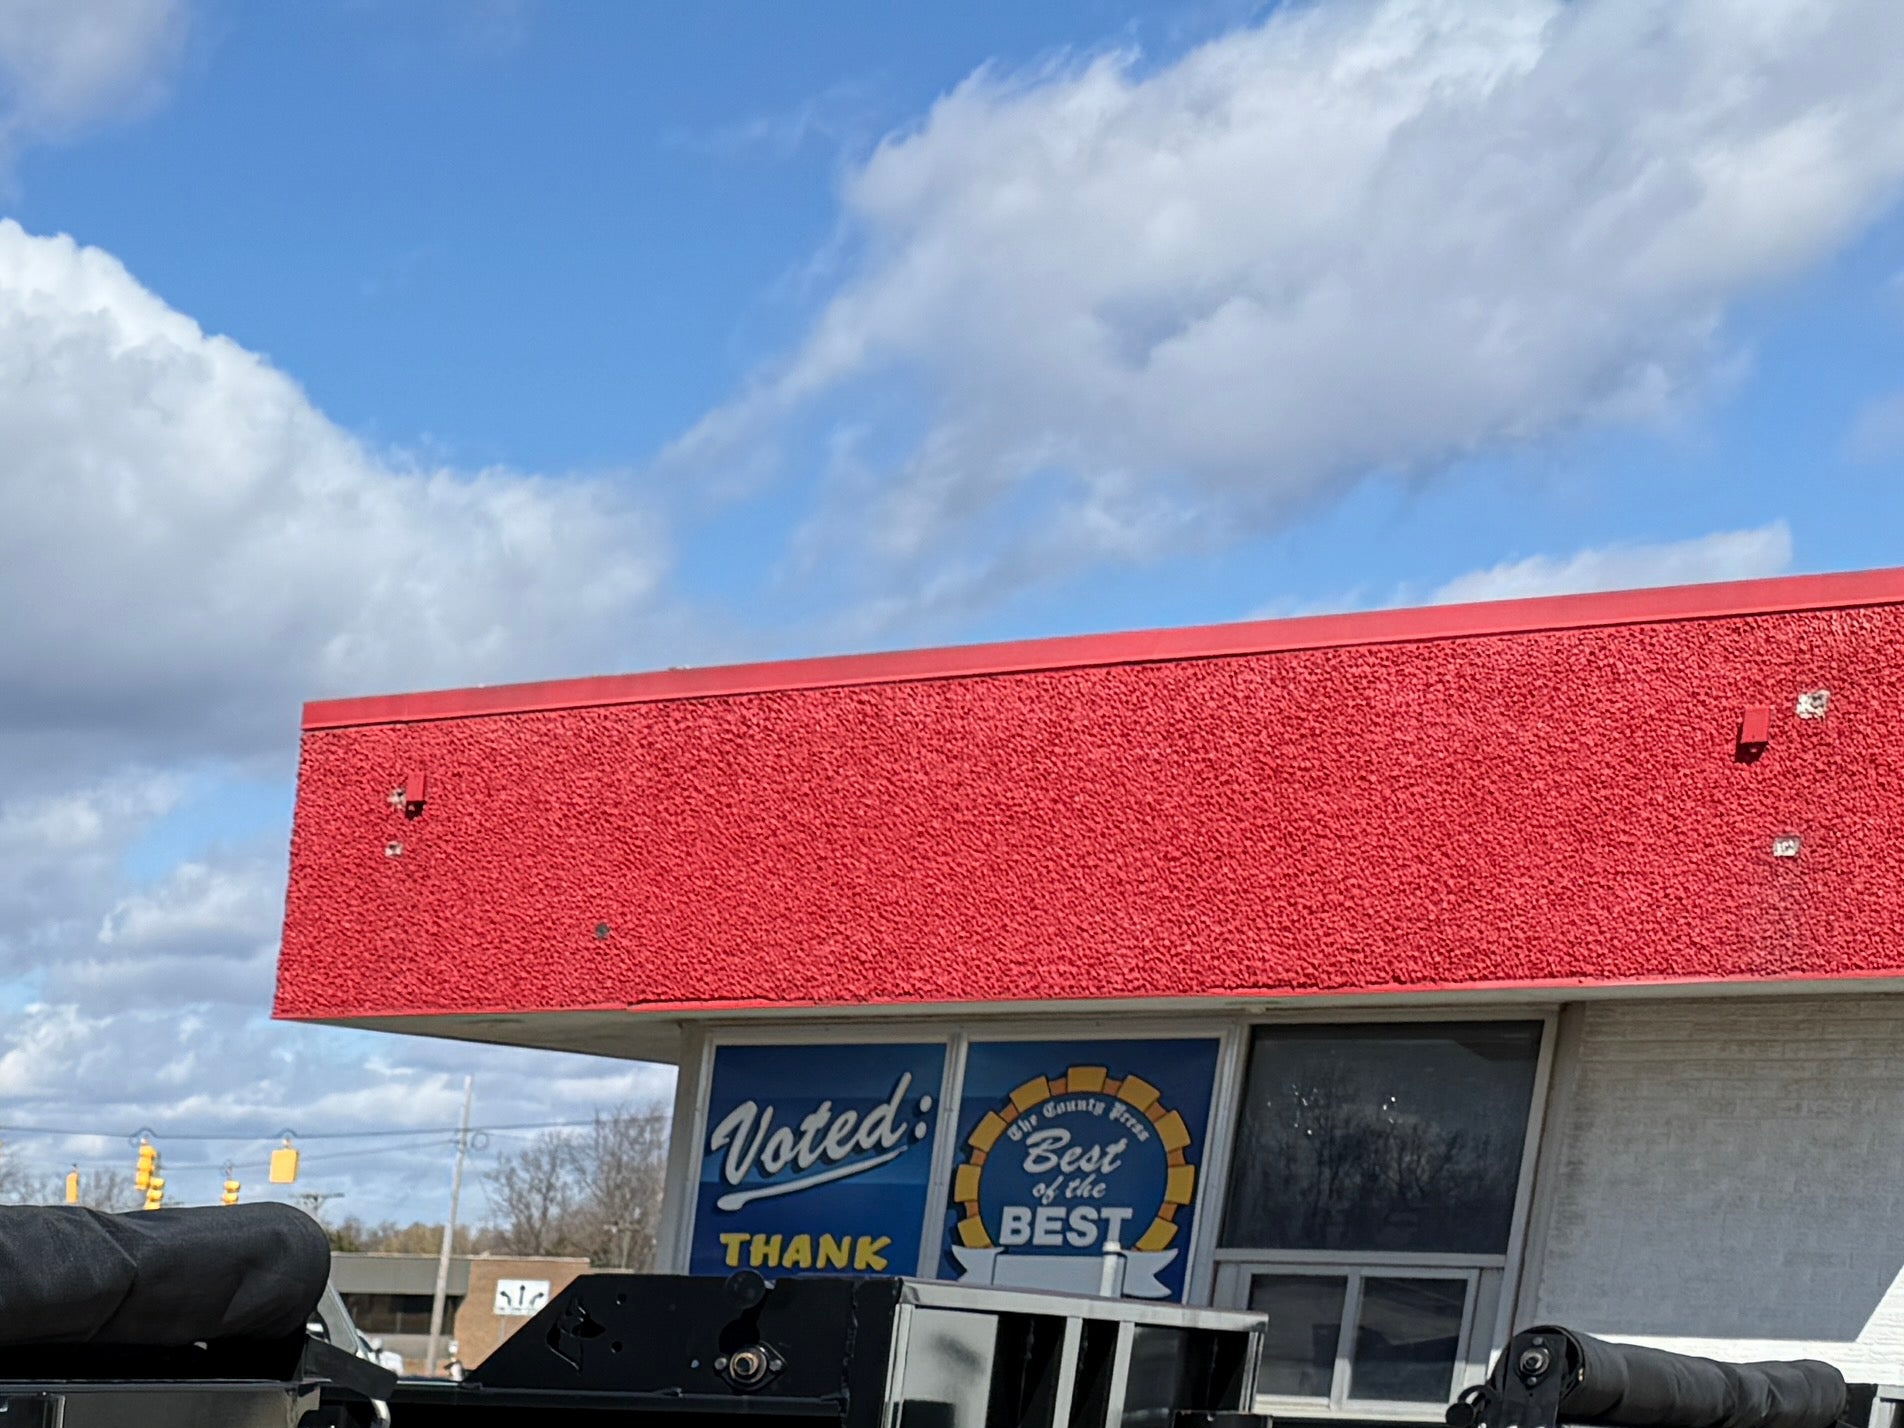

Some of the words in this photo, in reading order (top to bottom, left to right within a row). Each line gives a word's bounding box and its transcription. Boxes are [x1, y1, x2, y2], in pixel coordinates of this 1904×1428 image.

[710, 1071, 933, 1186] Voted:
[1043, 1098, 1106, 1118] County
[1109, 1102, 1151, 1142] Press
[1023, 1128, 1129, 1175] Best
[1032, 1175, 1065, 1205] of
[1065, 1173, 1107, 1199] the
[999, 1206, 1134, 1248] BEST
[719, 1232, 891, 1272] THANK
